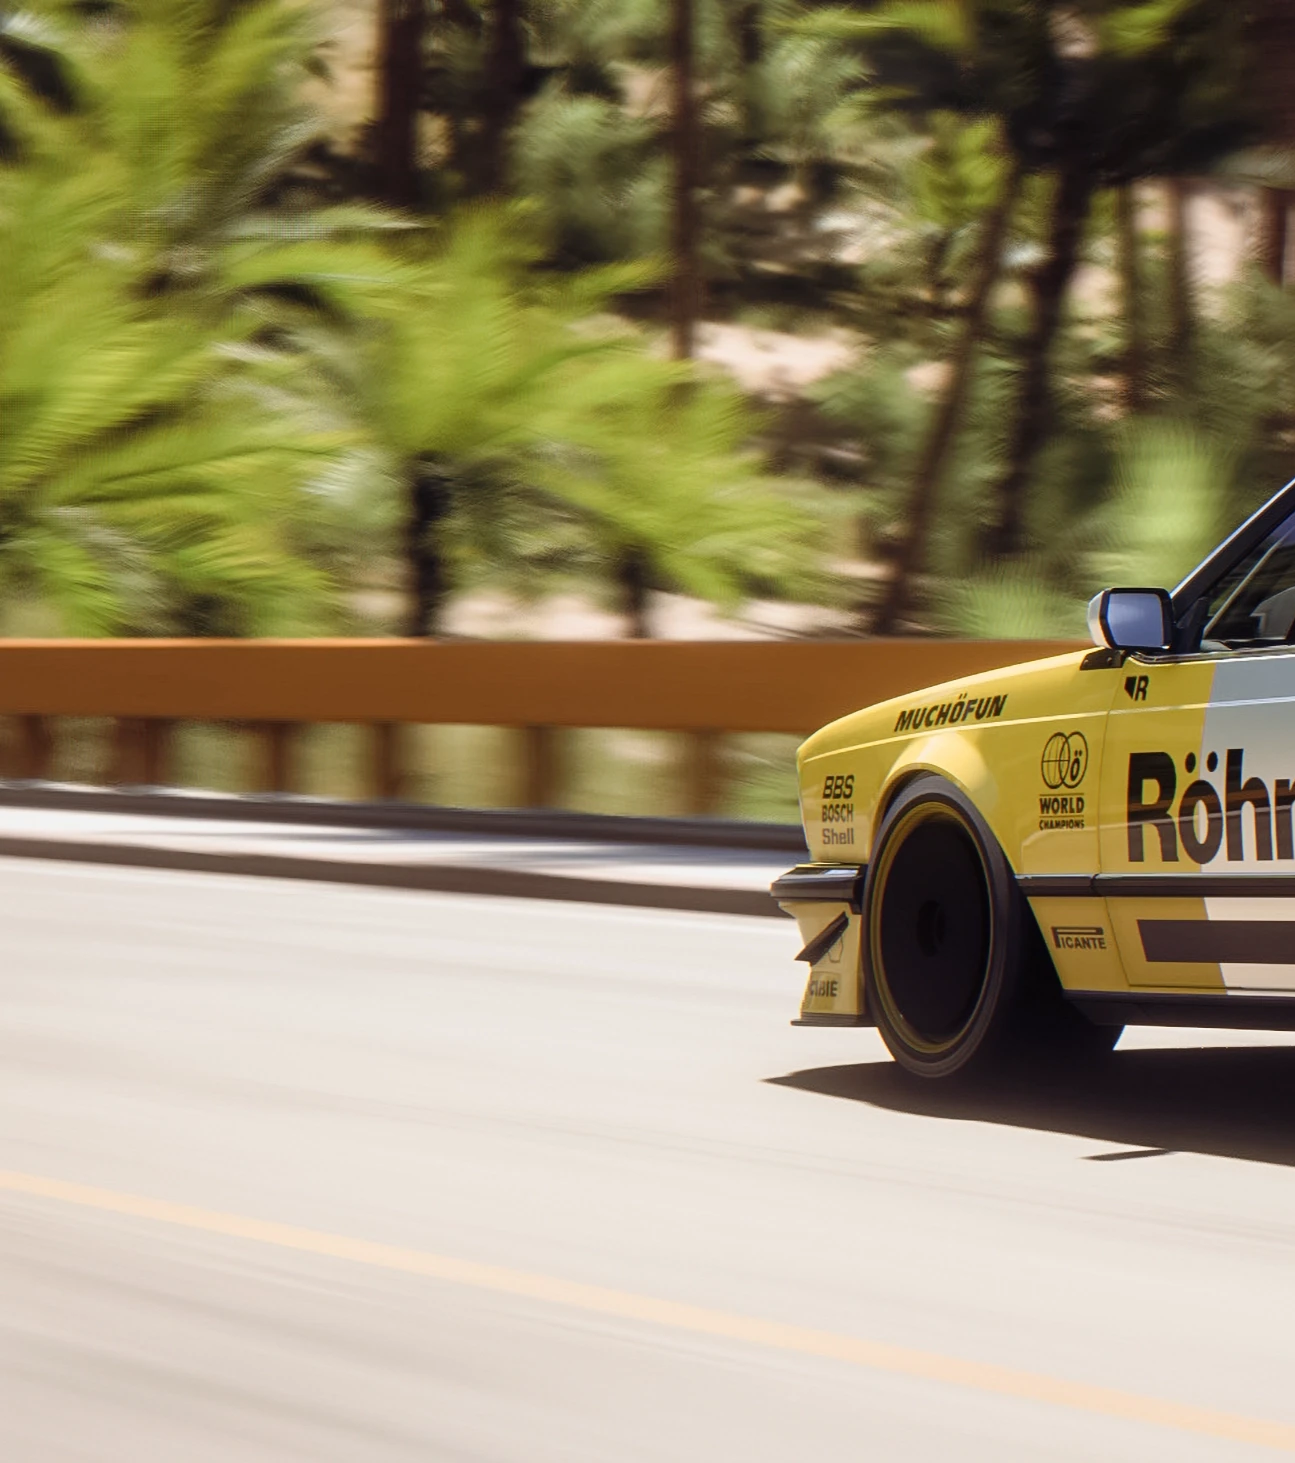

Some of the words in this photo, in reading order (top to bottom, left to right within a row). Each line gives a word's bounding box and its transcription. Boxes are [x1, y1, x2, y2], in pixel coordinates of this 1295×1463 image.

[894, 692, 1008, 733] MUCHÖFUN
[822, 774, 855, 799] BBS
[821, 803, 854, 823] BOSCH
[1039, 796, 1085, 814] WORLD
[1039, 819, 1085, 831] CHAMPIONS
[822, 827, 854, 846] Shell
[1051, 926, 1107, 949] PICANTE
